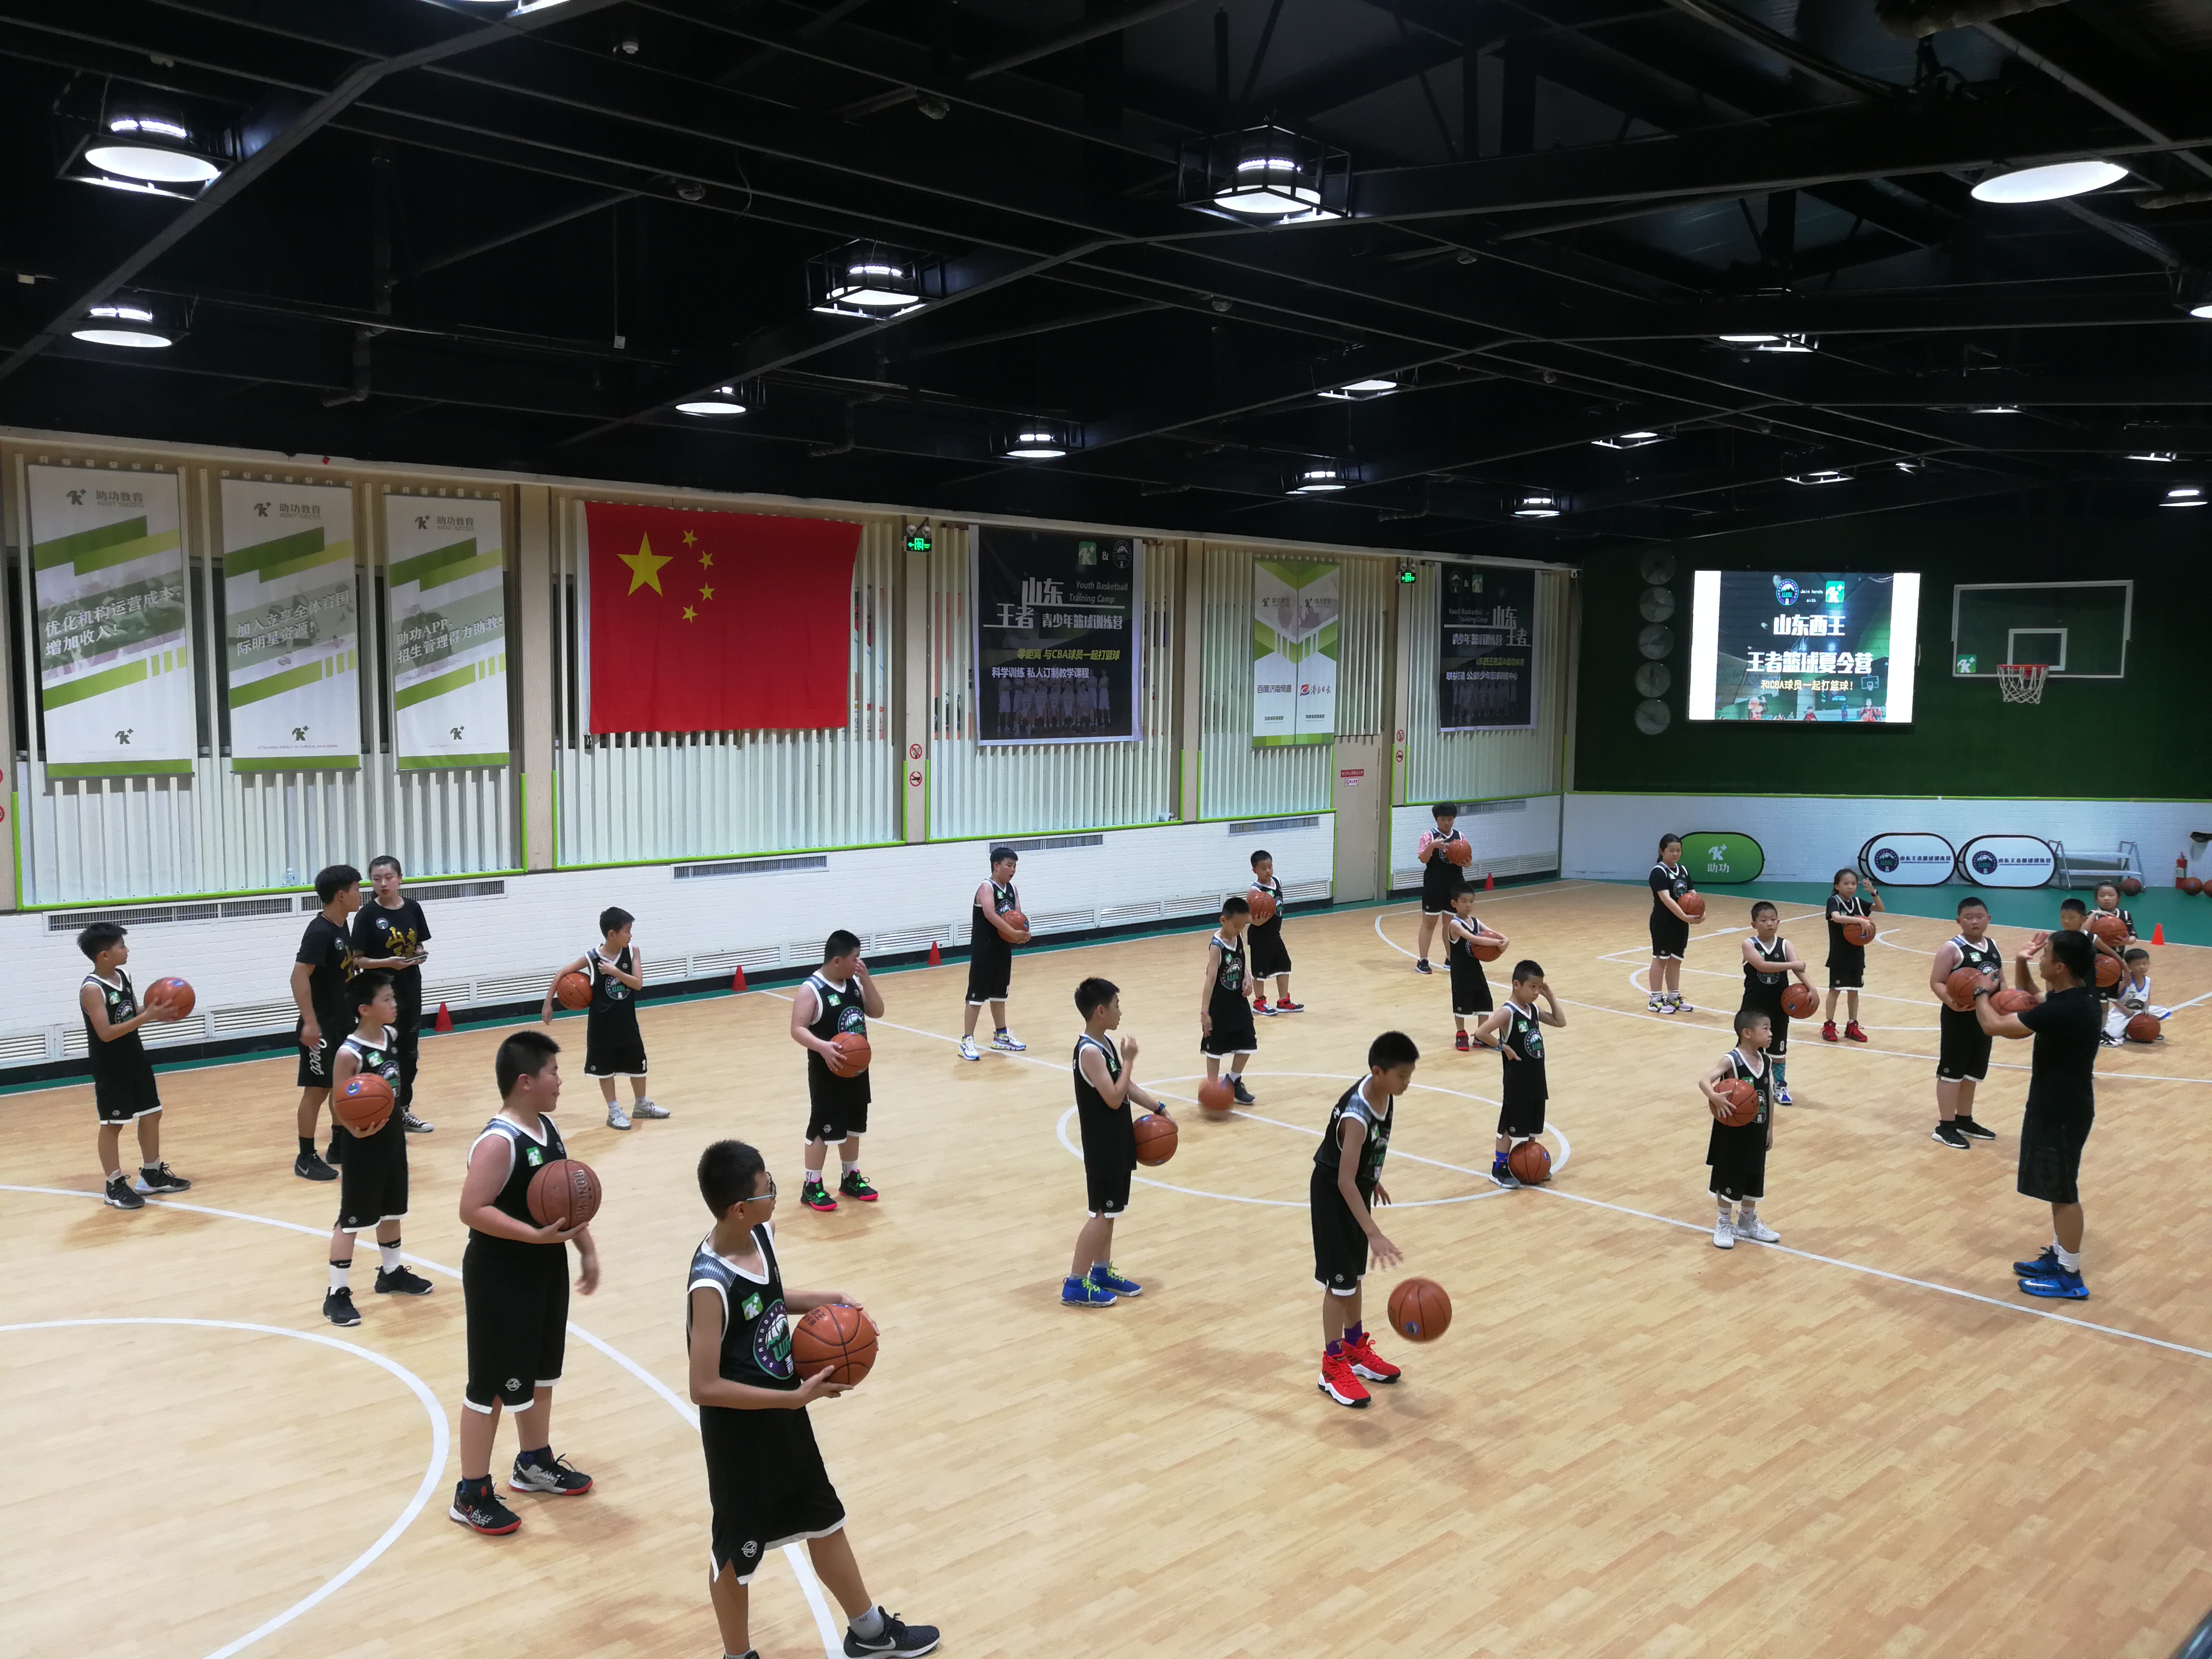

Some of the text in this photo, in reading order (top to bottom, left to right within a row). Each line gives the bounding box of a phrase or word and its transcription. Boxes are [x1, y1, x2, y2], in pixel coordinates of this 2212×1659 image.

[96, 491, 143, 502] 助功教育
[279, 503, 321, 515] 助功教育
[436, 516, 474, 526] 助功教育
[1076, 580, 1128, 591] Youth Basketball
[1069, 593, 1115, 605] Training Camp
[1041, 613, 1123, 629] 青少年篮球训练营
[1773, 614, 1846, 636] 山东西王
[1746, 651, 1874, 675] 王者篮球夏令营
[992, 666, 1090, 679] 科学训练 私人订制教学课程
[1707, 863, 1729, 873] 助功
